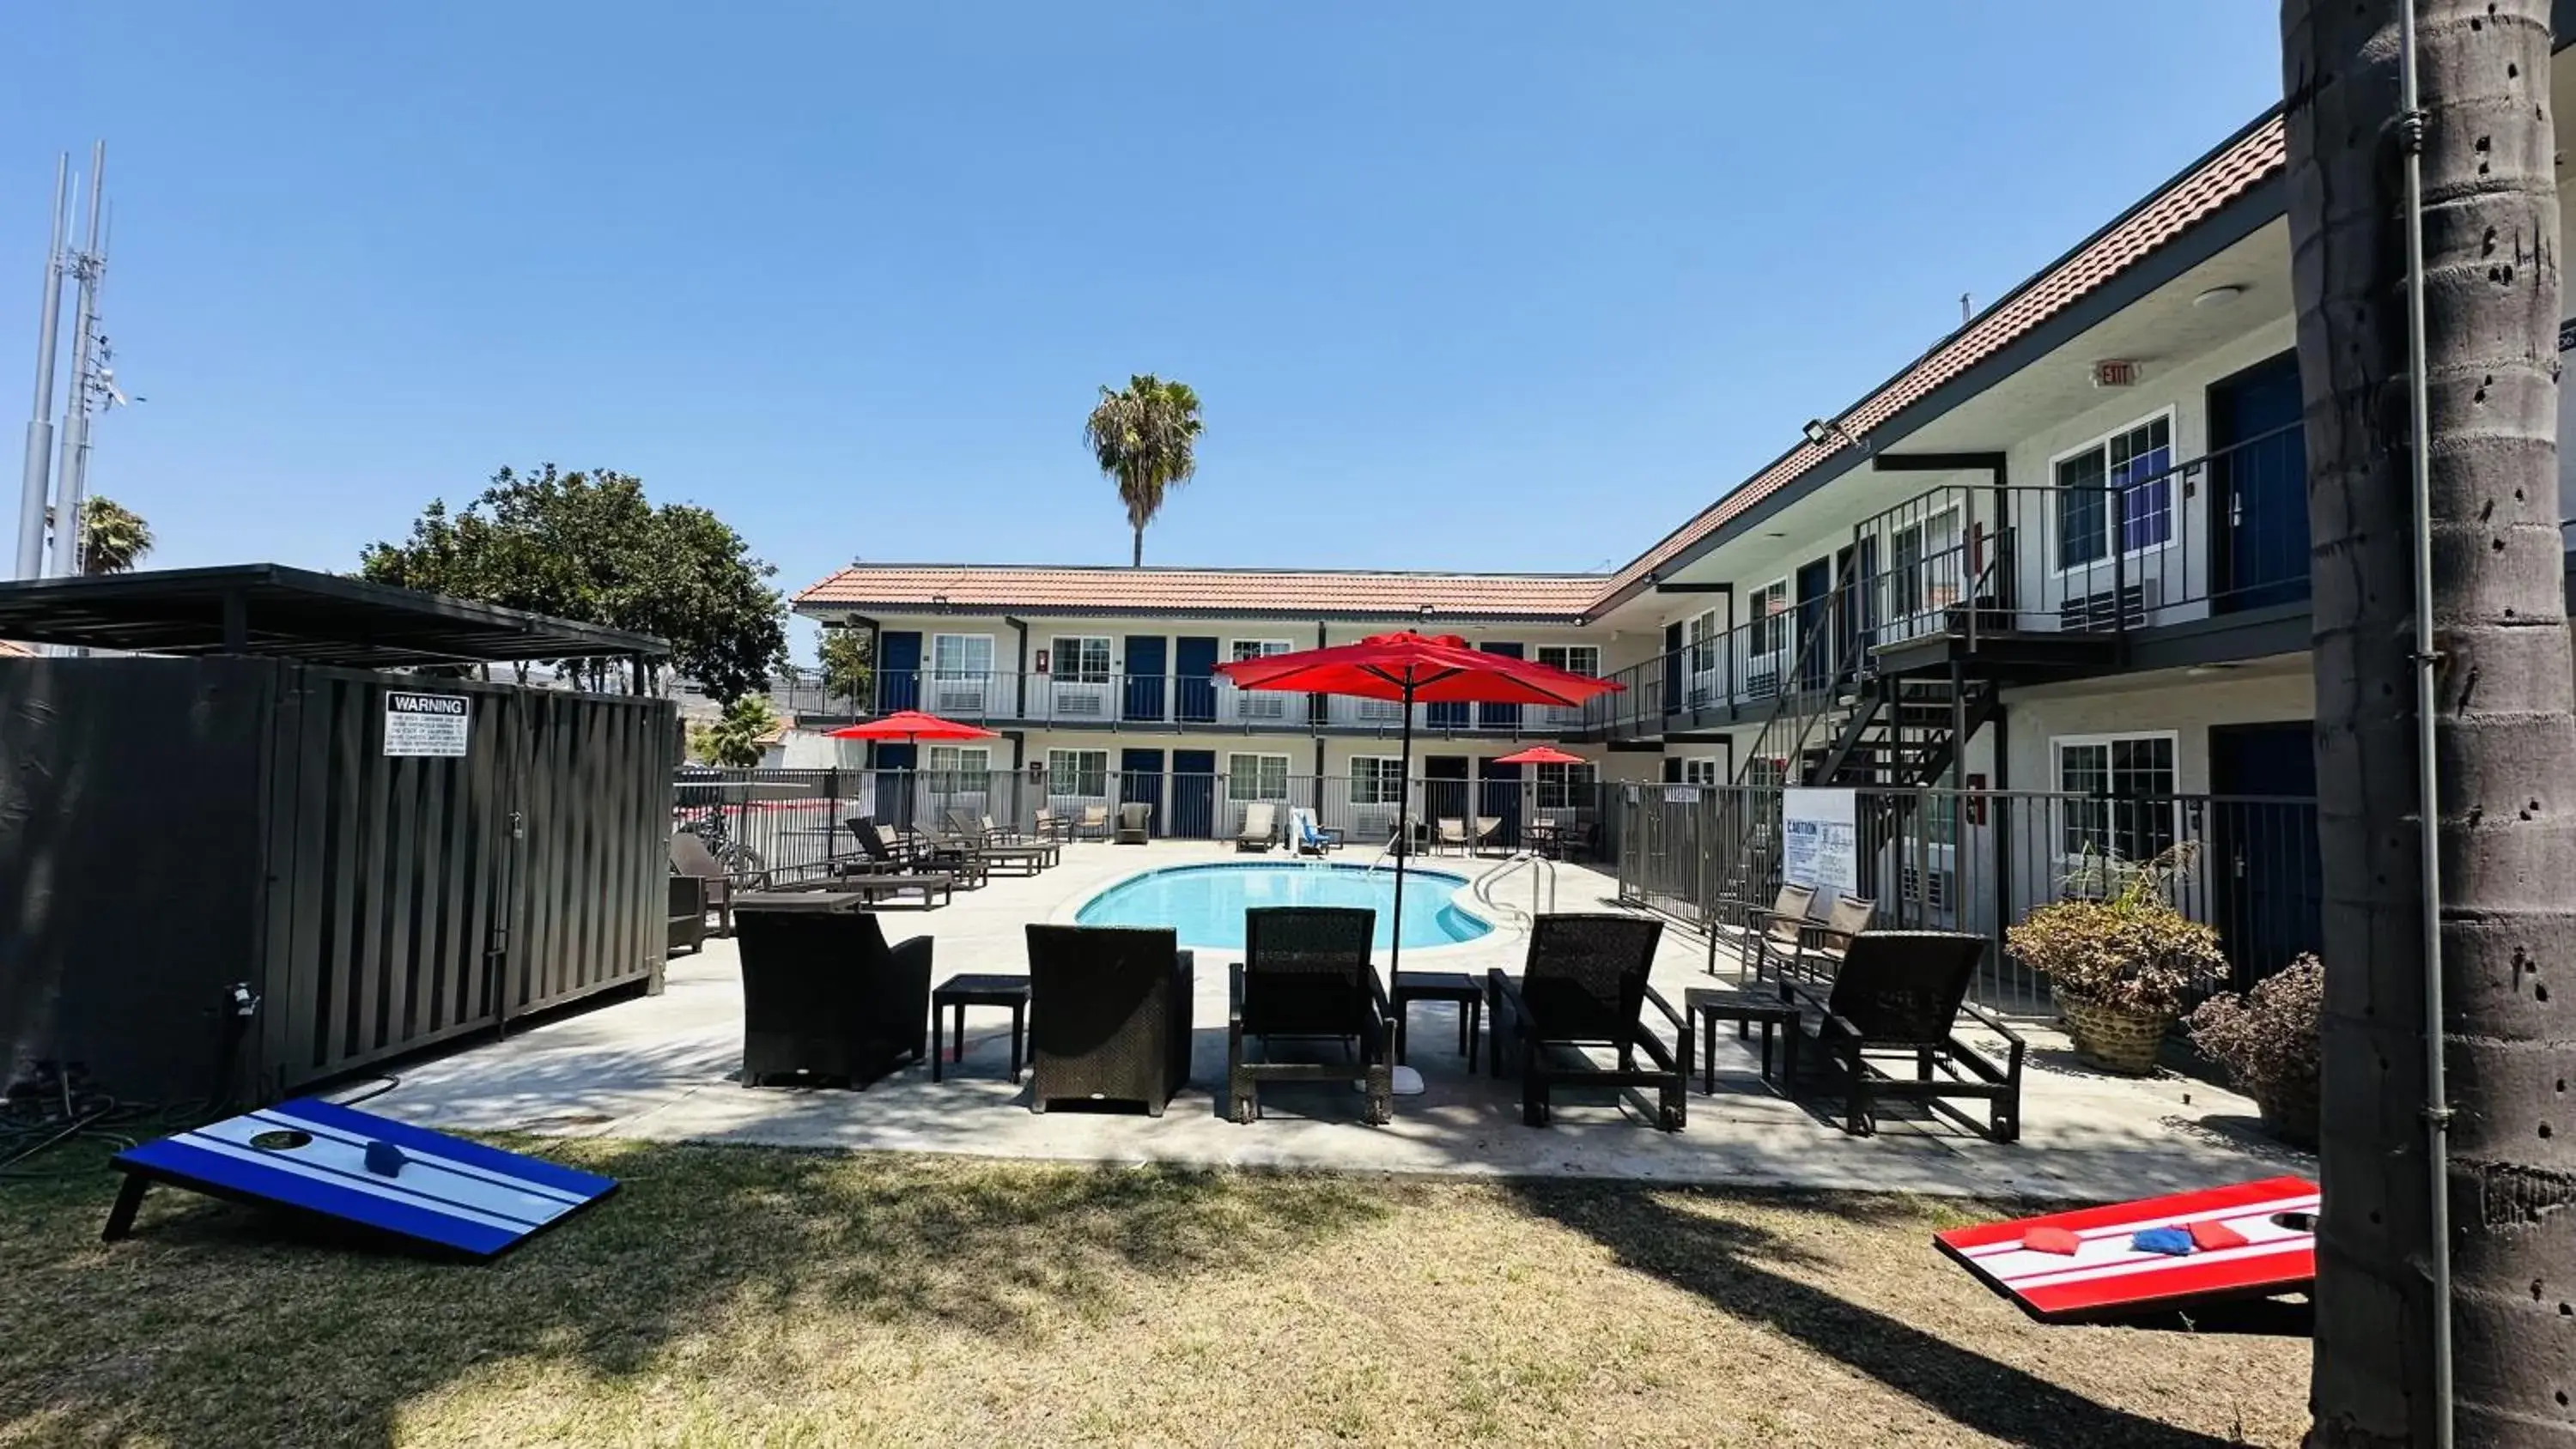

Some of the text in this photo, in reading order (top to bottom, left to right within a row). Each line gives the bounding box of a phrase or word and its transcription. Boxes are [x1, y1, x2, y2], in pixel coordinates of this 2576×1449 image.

[2103, 365, 2129, 385] EXIT
[395, 696, 462, 713] WARNING
[1787, 820, 1817, 834] CAUTION
